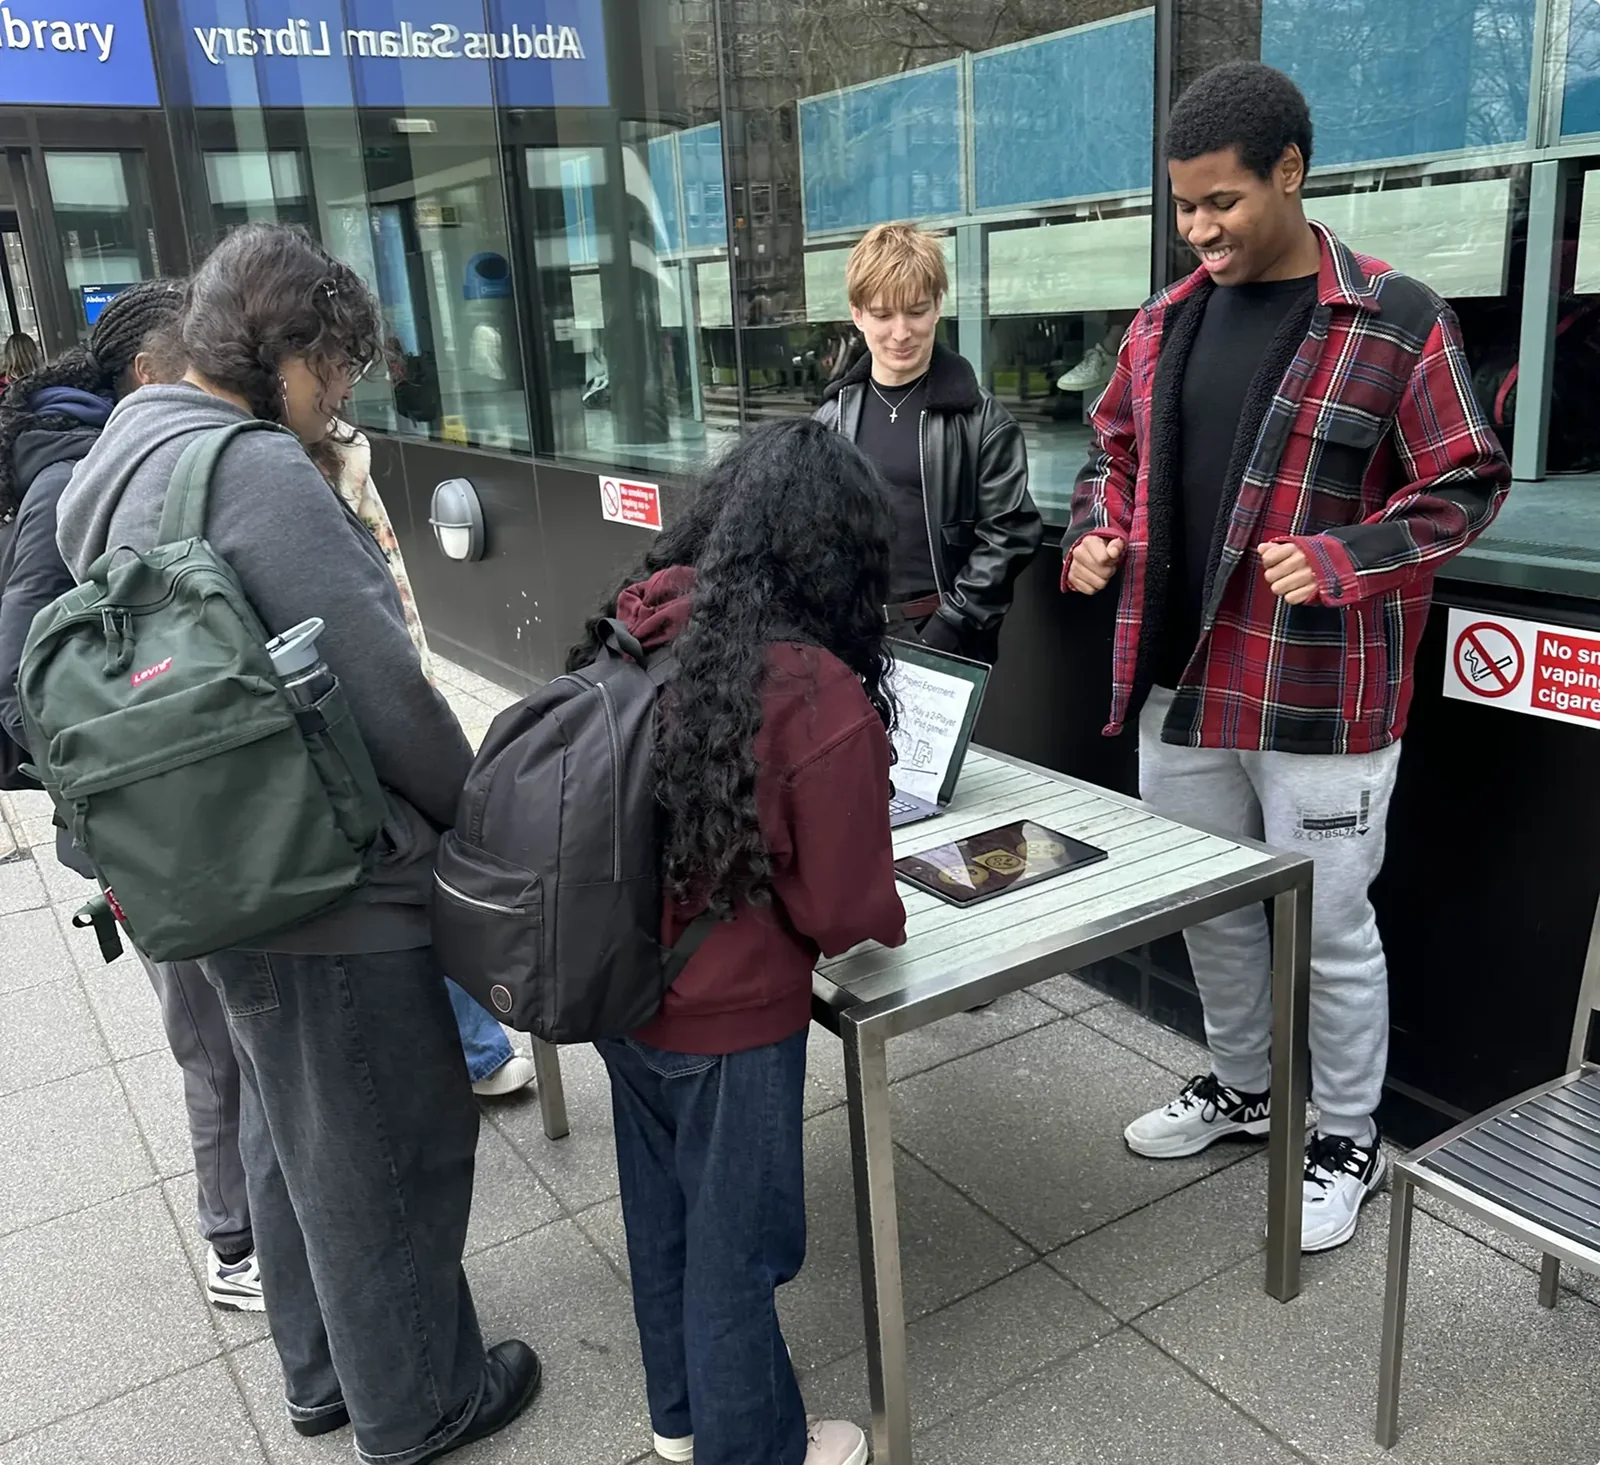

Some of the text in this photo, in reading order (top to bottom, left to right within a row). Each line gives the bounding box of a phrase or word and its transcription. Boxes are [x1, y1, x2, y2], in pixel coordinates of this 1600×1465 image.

[0, 7, 114, 62] brary
[628, 489, 648, 501] smoking
[1542, 638, 1572, 660] No
[1540, 665, 1600, 694] vapin
[1325, 827, 1356, 839] BSL72
